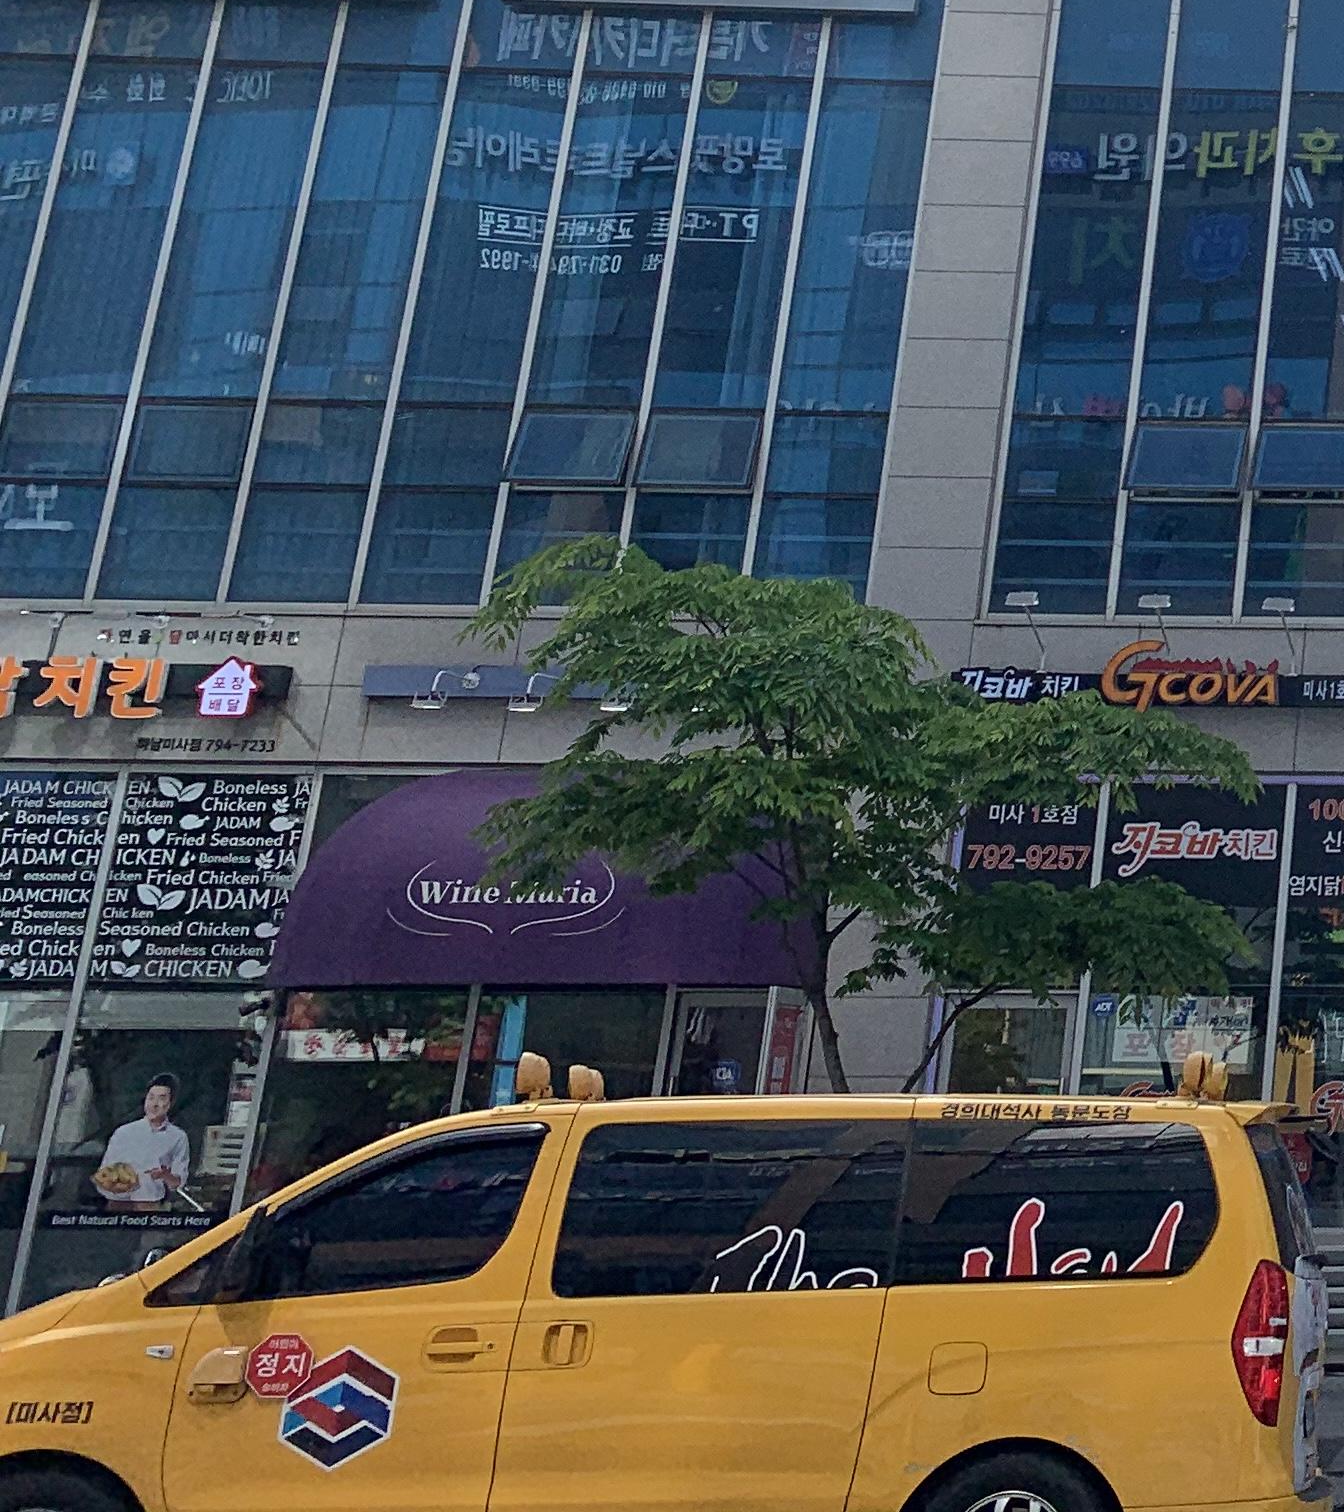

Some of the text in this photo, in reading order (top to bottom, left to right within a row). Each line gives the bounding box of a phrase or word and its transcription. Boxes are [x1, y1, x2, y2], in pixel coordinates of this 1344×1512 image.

[1101, 639, 1280, 713] GCOVA
[205, 739, 276, 754] 794-7233
[213, 780, 287, 795] Boneless
[11, 798, 43, 809] Fried
[47, 797, 108, 809] Seasoned
[201, 797, 267, 812] Chicken
[15, 810, 90, 825] Boneless
[987, 803, 1025, 825] 미사
[213, 816, 262, 831] JADAM
[1, 828, 50, 845] Fried
[166, 832, 284, 847] Fried Seasoned
[967, 844, 1091, 872] 792-9257
[23, 871, 76, 882] easoned
[146, 869, 195, 886] Fried
[198, 869, 260, 886] Chicken
[420, 879, 500, 905] Wine
[185, 888, 271, 915] JADAM
[11, 922, 250, 937] Boneless Seasoned Chicken
[145, 944, 265, 956] Boneless Chicken
[144, 960, 232, 977] CHICKEN
[52, 1214, 210, 1226] Best Natural Food Starts Here
[255, 1351, 307, 1378] 정지
